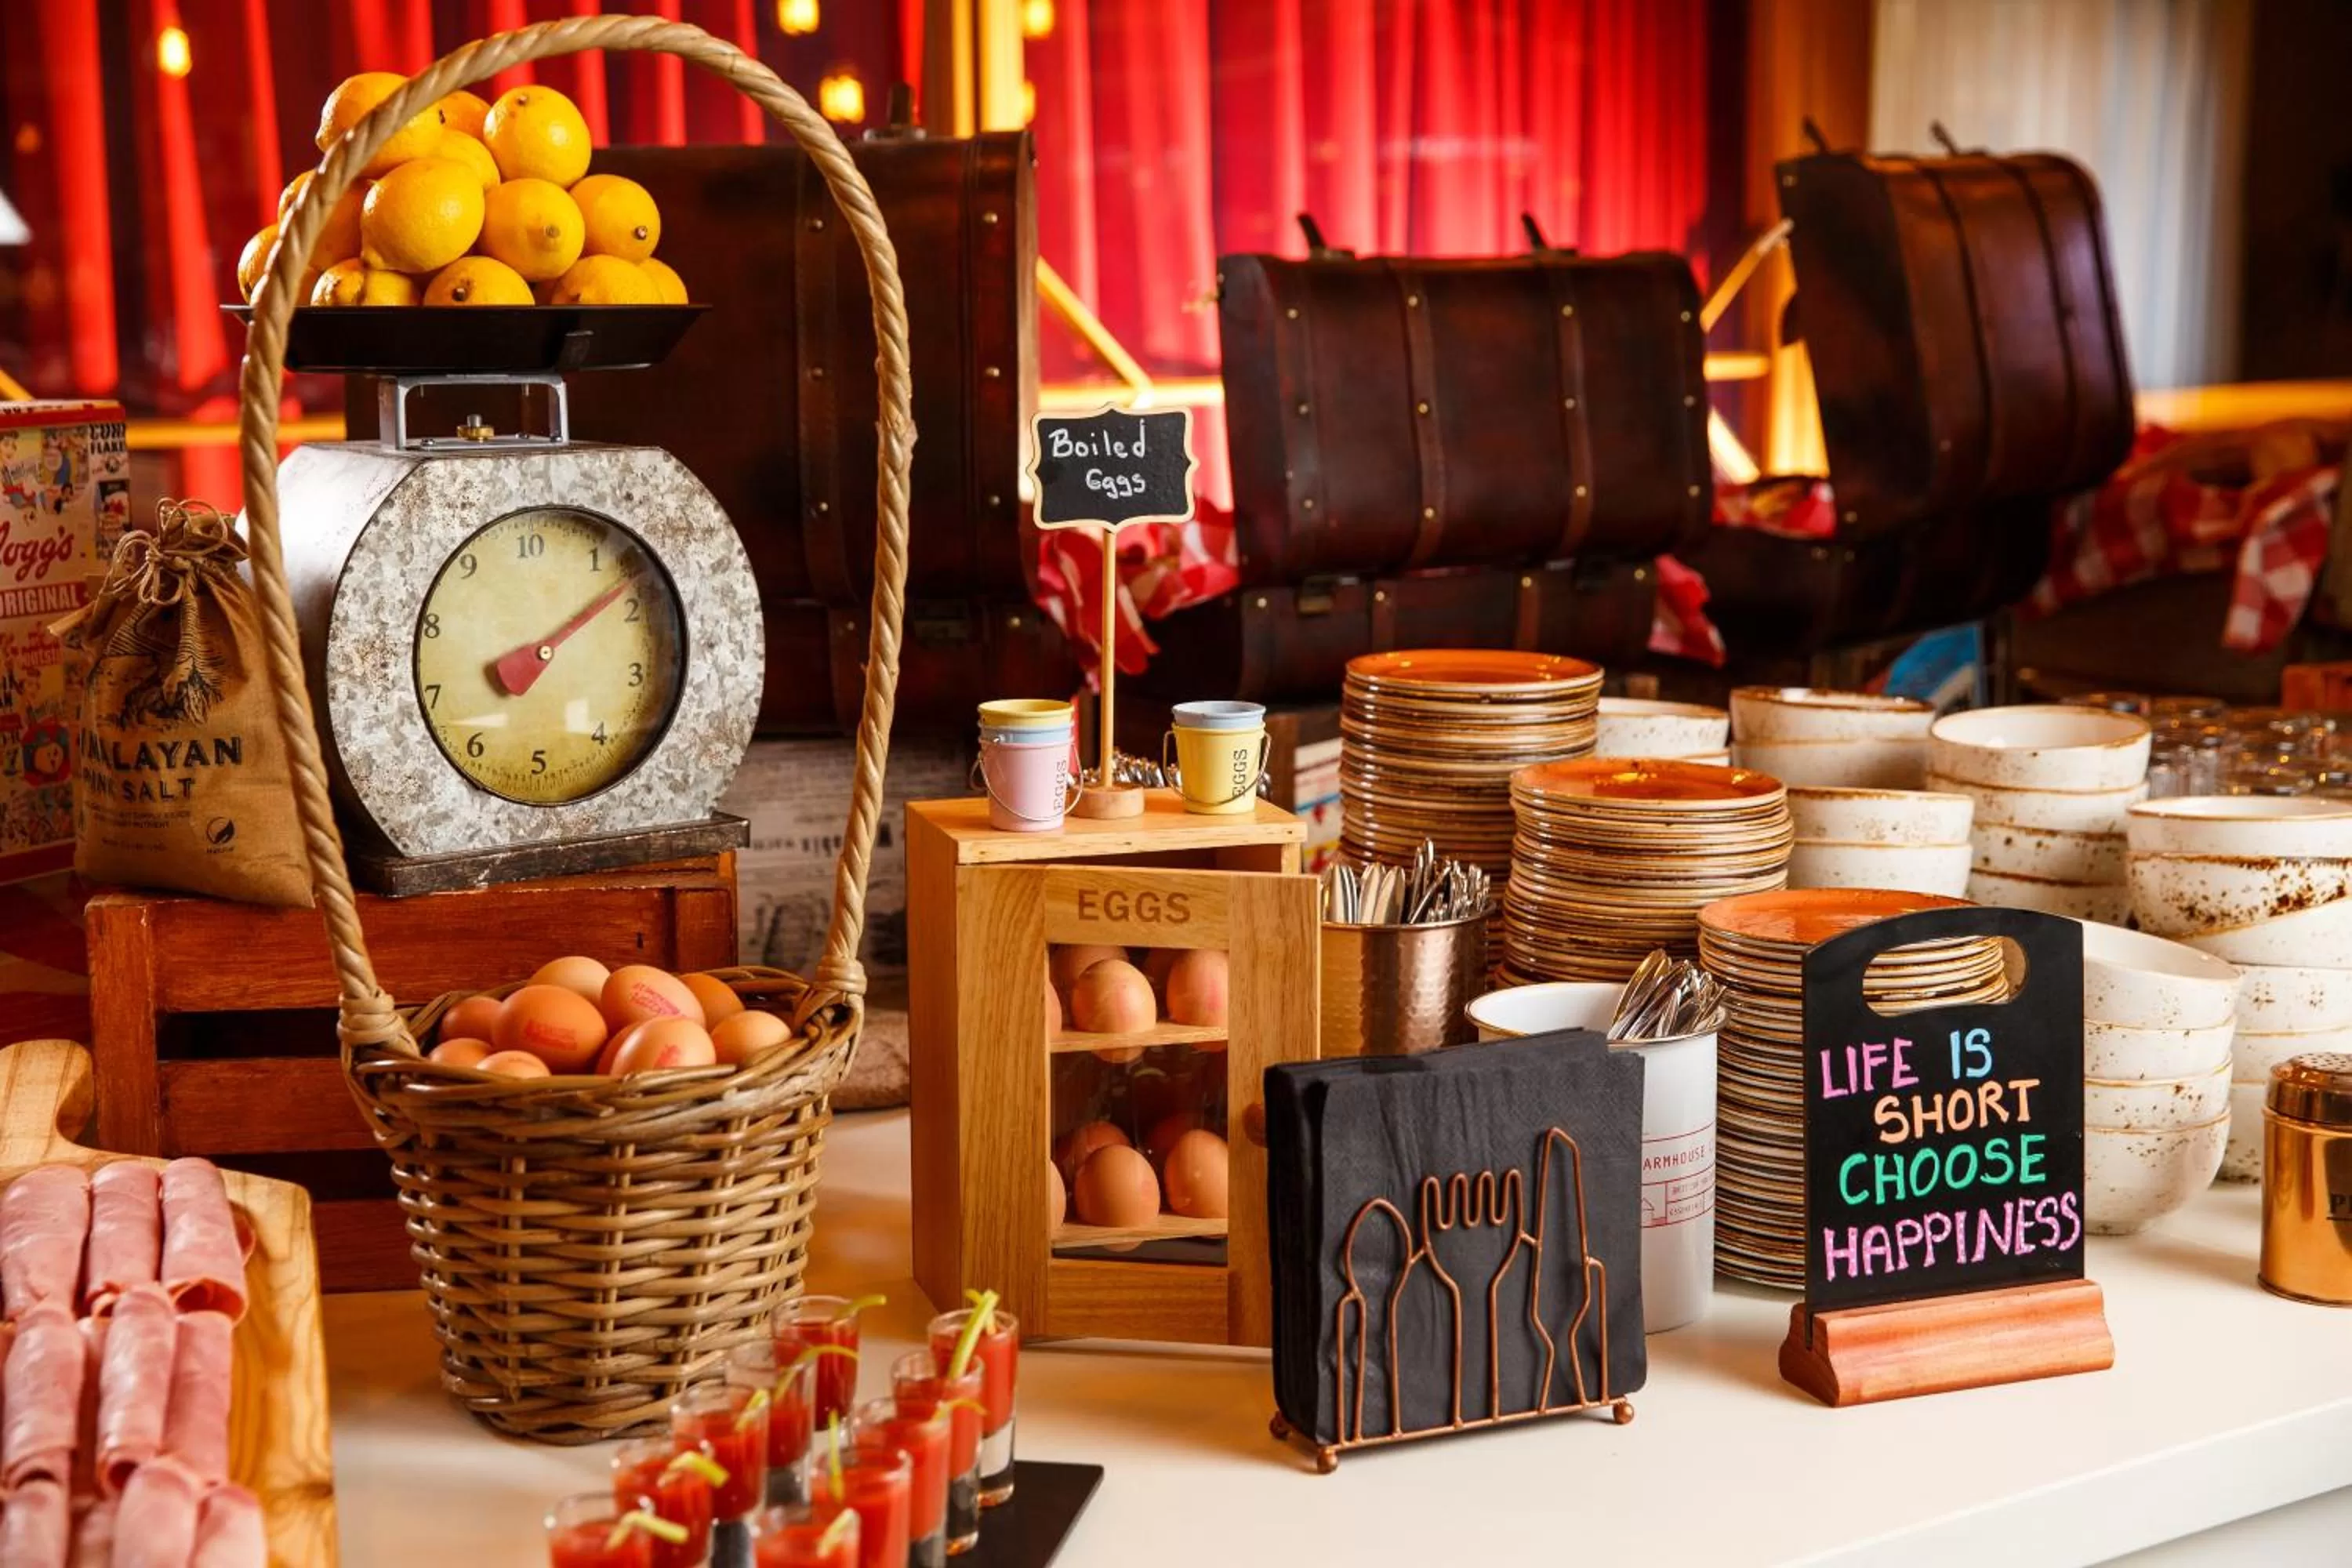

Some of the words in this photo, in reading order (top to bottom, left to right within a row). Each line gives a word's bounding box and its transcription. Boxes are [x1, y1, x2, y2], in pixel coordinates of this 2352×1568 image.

[1048, 418, 1146, 459] Boiled
[1085, 468, 1146, 499] Eggs
[517, 534, 545, 559] 10
[459, 554, 477, 580] 9
[588, 548, 602, 572] 1
[623, 597, 641, 623] 2
[423, 613, 441, 639] 8
[628, 663, 644, 688] 3
[425, 684, 442, 710] 7
[466, 731, 485, 758] 6
[590, 720, 608, 746] 4
[530, 749, 547, 775] 5
[1232, 748, 1247, 799] EGGS
[122, 777, 195, 803] SALT
[1077, 888, 1192, 924] EGGS
[1820, 1037, 1919, 1099] LIFE
[1949, 1028, 1993, 1080] IS
[1873, 1078, 2041, 1145] SHORT
[1838, 1134, 2046, 1205] CHOOSE
[1823, 1191, 2082, 1283] HAPPINESS
